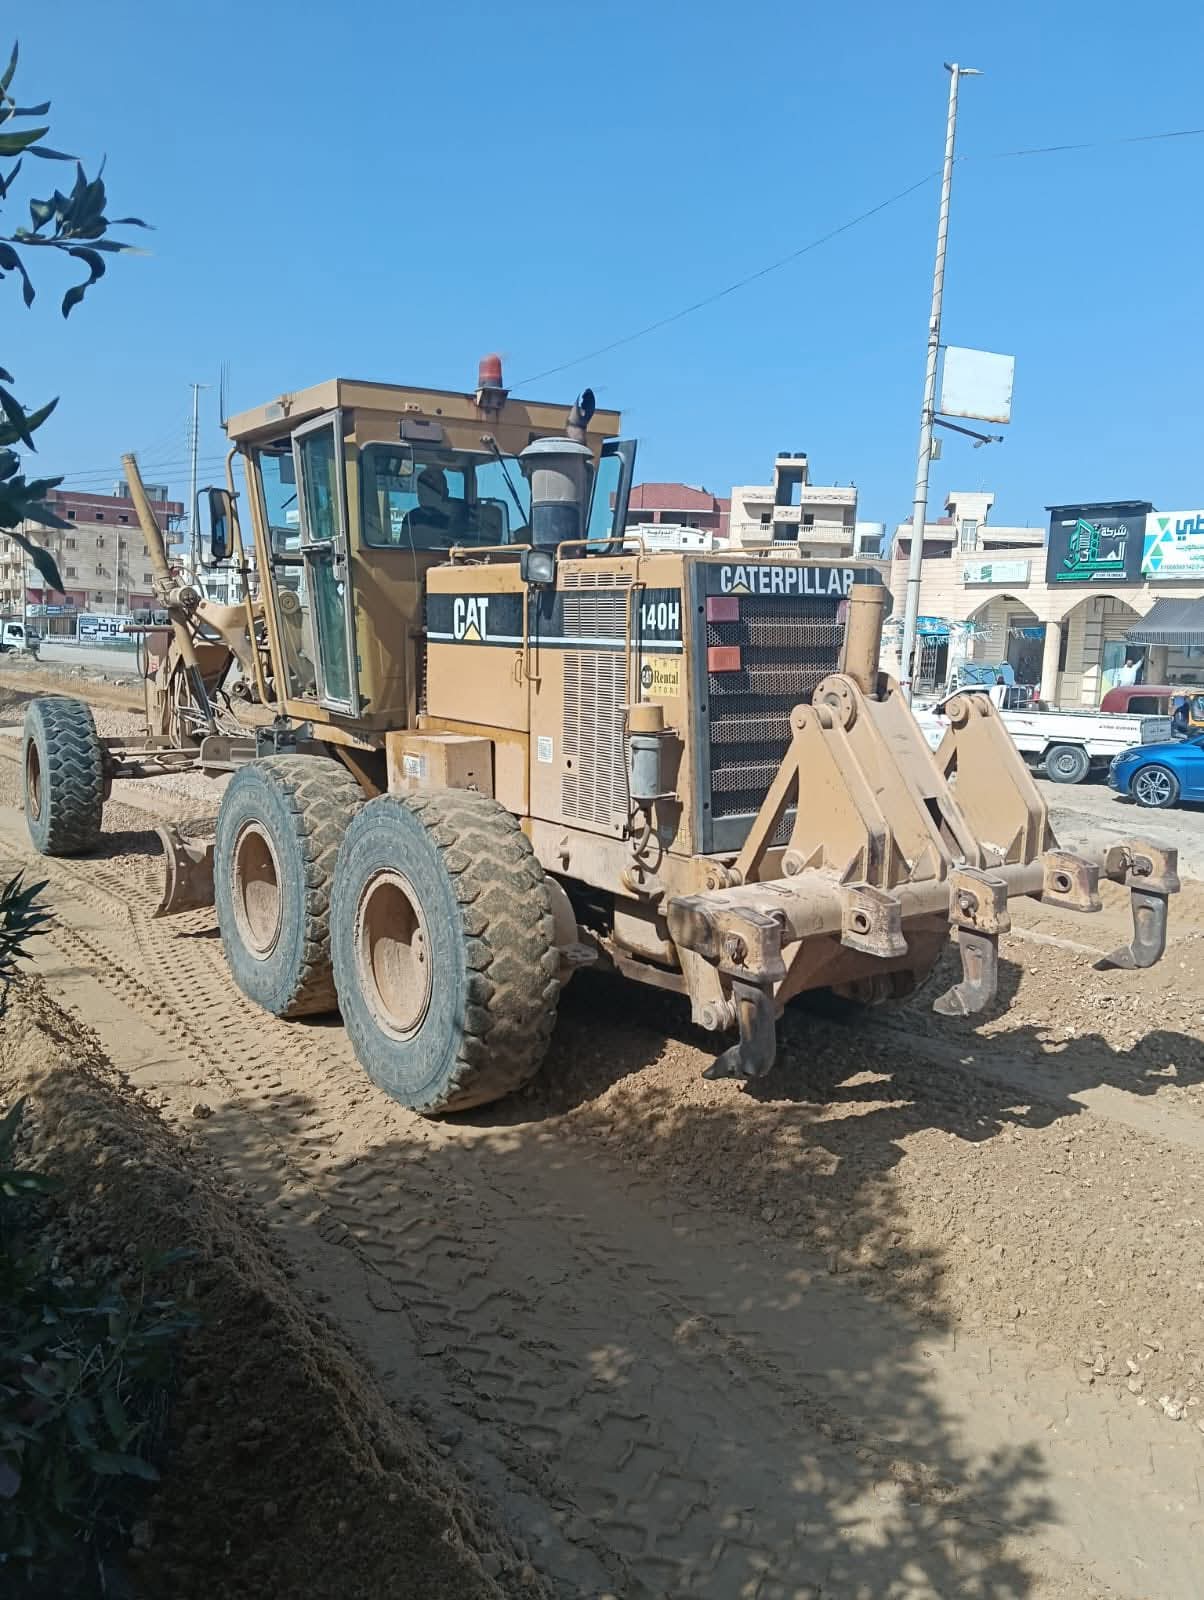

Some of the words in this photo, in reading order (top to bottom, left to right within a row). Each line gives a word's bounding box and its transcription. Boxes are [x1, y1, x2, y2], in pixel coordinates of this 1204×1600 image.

[1101, 525, 1127, 538] شركة
[720, 566, 855, 594] CATERPILLAR
[453, 597, 489, 641] CAT
[640, 602, 680, 631] 140H
[654, 670, 679, 684] Rental
